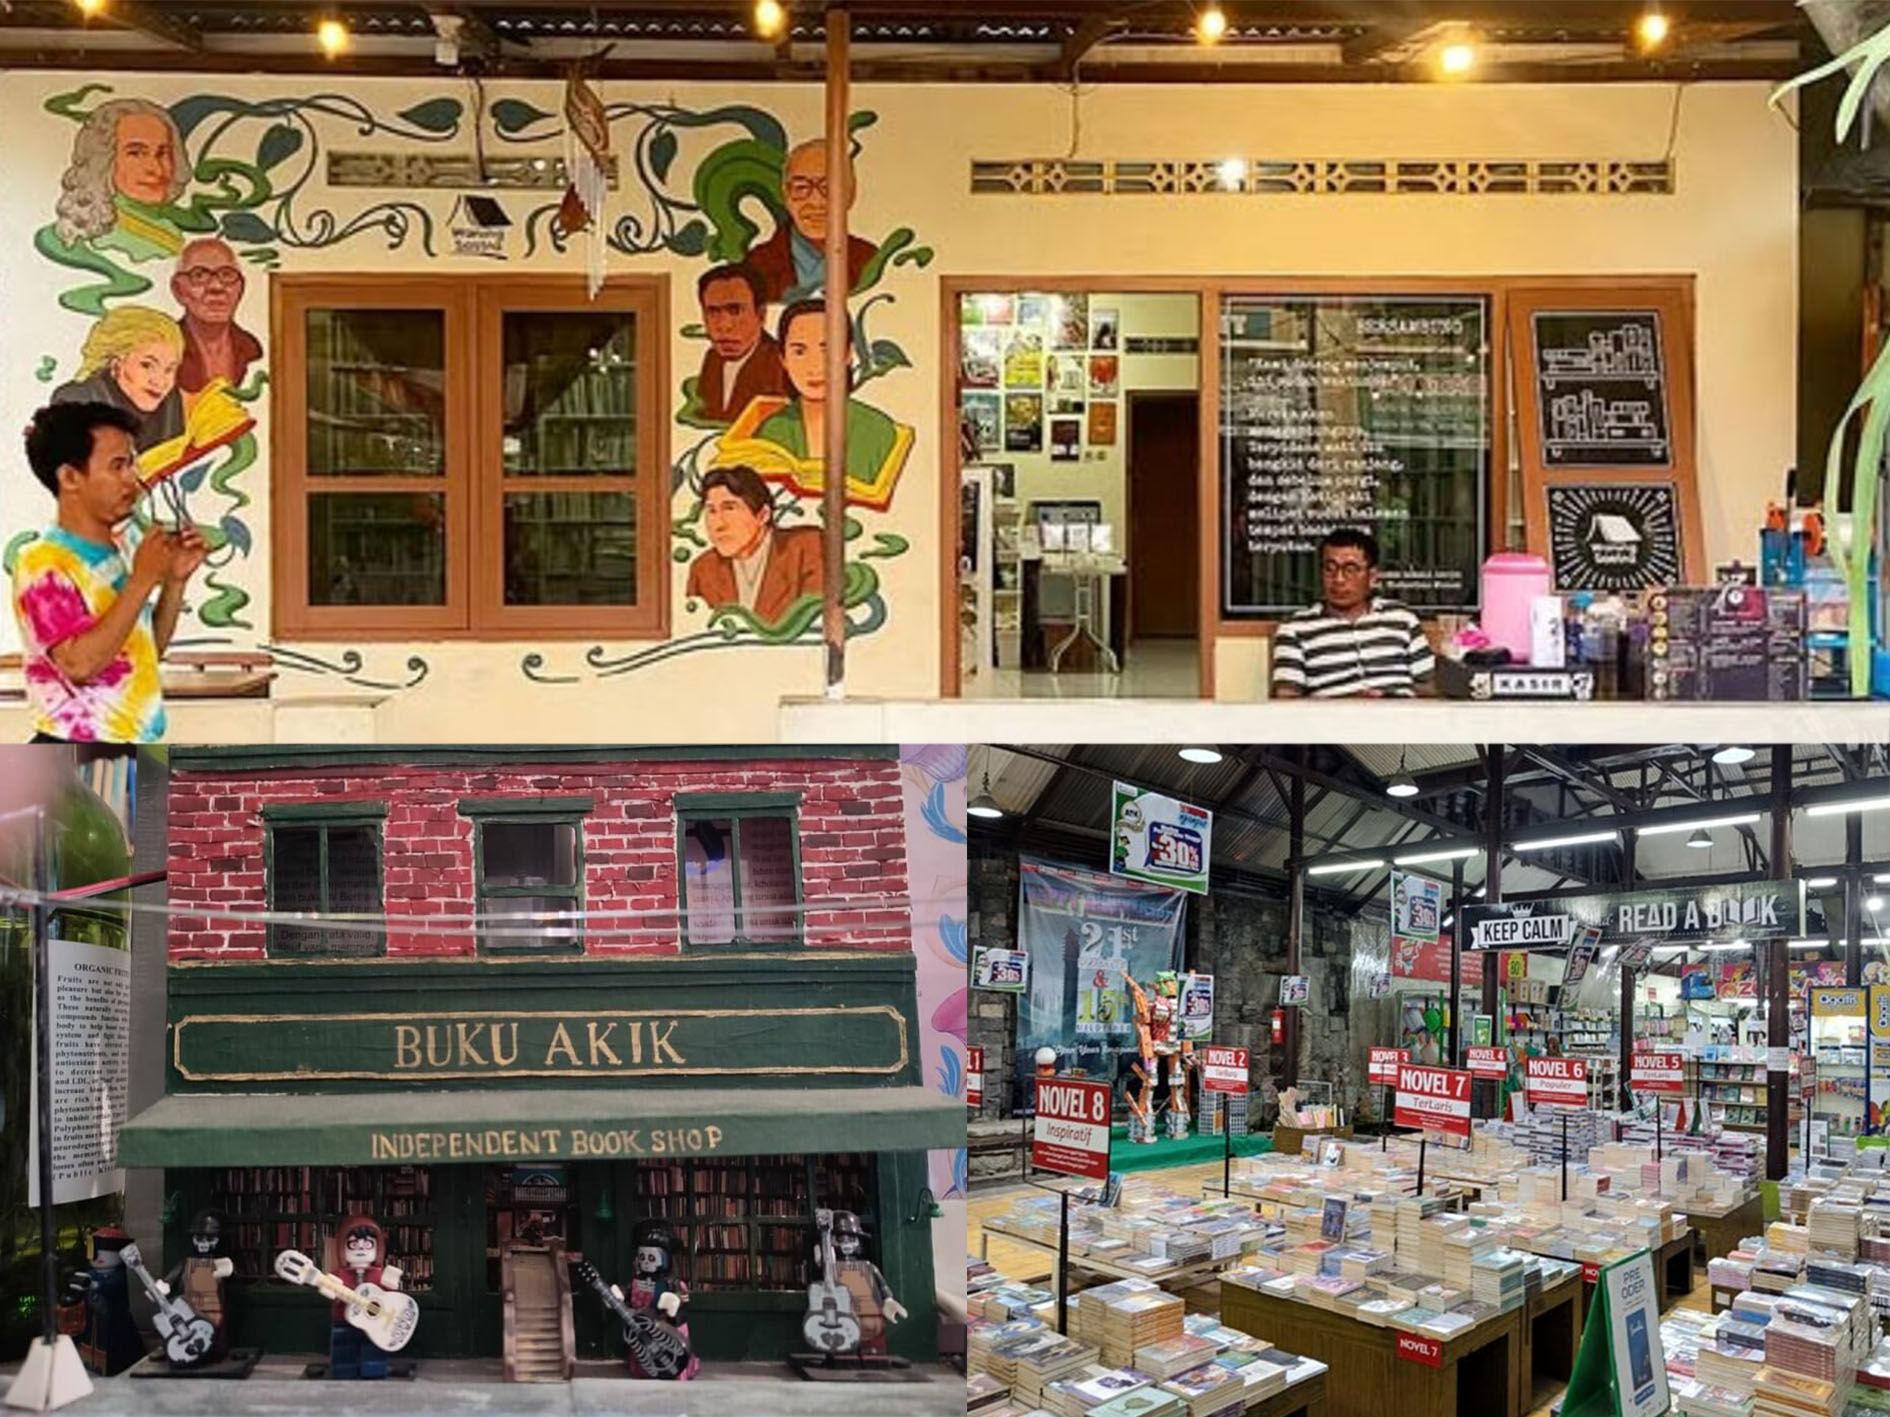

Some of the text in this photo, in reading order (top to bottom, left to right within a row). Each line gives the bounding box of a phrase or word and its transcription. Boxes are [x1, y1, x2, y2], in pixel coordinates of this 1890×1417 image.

[1619, 902, 1677, 932] READ
[1684, 900, 1700, 930] A
[1484, 918, 1562, 942] KEEP CALM
[74, 963, 113, 974] ORGANIC
[57, 975, 82, 984] Fruits
[57, 985, 88, 993] pleasure
[394, 1020, 687, 1068] BUKU AKIK
[1208, 1050, 1246, 1067] NOVEL 2
[1371, 1050, 1398, 1063] NOVEL
[1469, 1048, 1504, 1061] NOVEL 4
[1634, 1055, 1680, 1069] NOVEL 5
[1528, 1059, 1583, 1078] NOVEL 6
[1400, 1069, 1466, 1097] NOVEL 7
[1038, 1085, 1105, 1121] NOVEL 8
[371, 1125, 723, 1159] INDEPENDENT BOOK SHOP
[1047, 1122, 1093, 1146] Inspiratif
[1623, 1267, 1641, 1285] PRE
[1400, 1338, 1438, 1357] NOVEL 7
